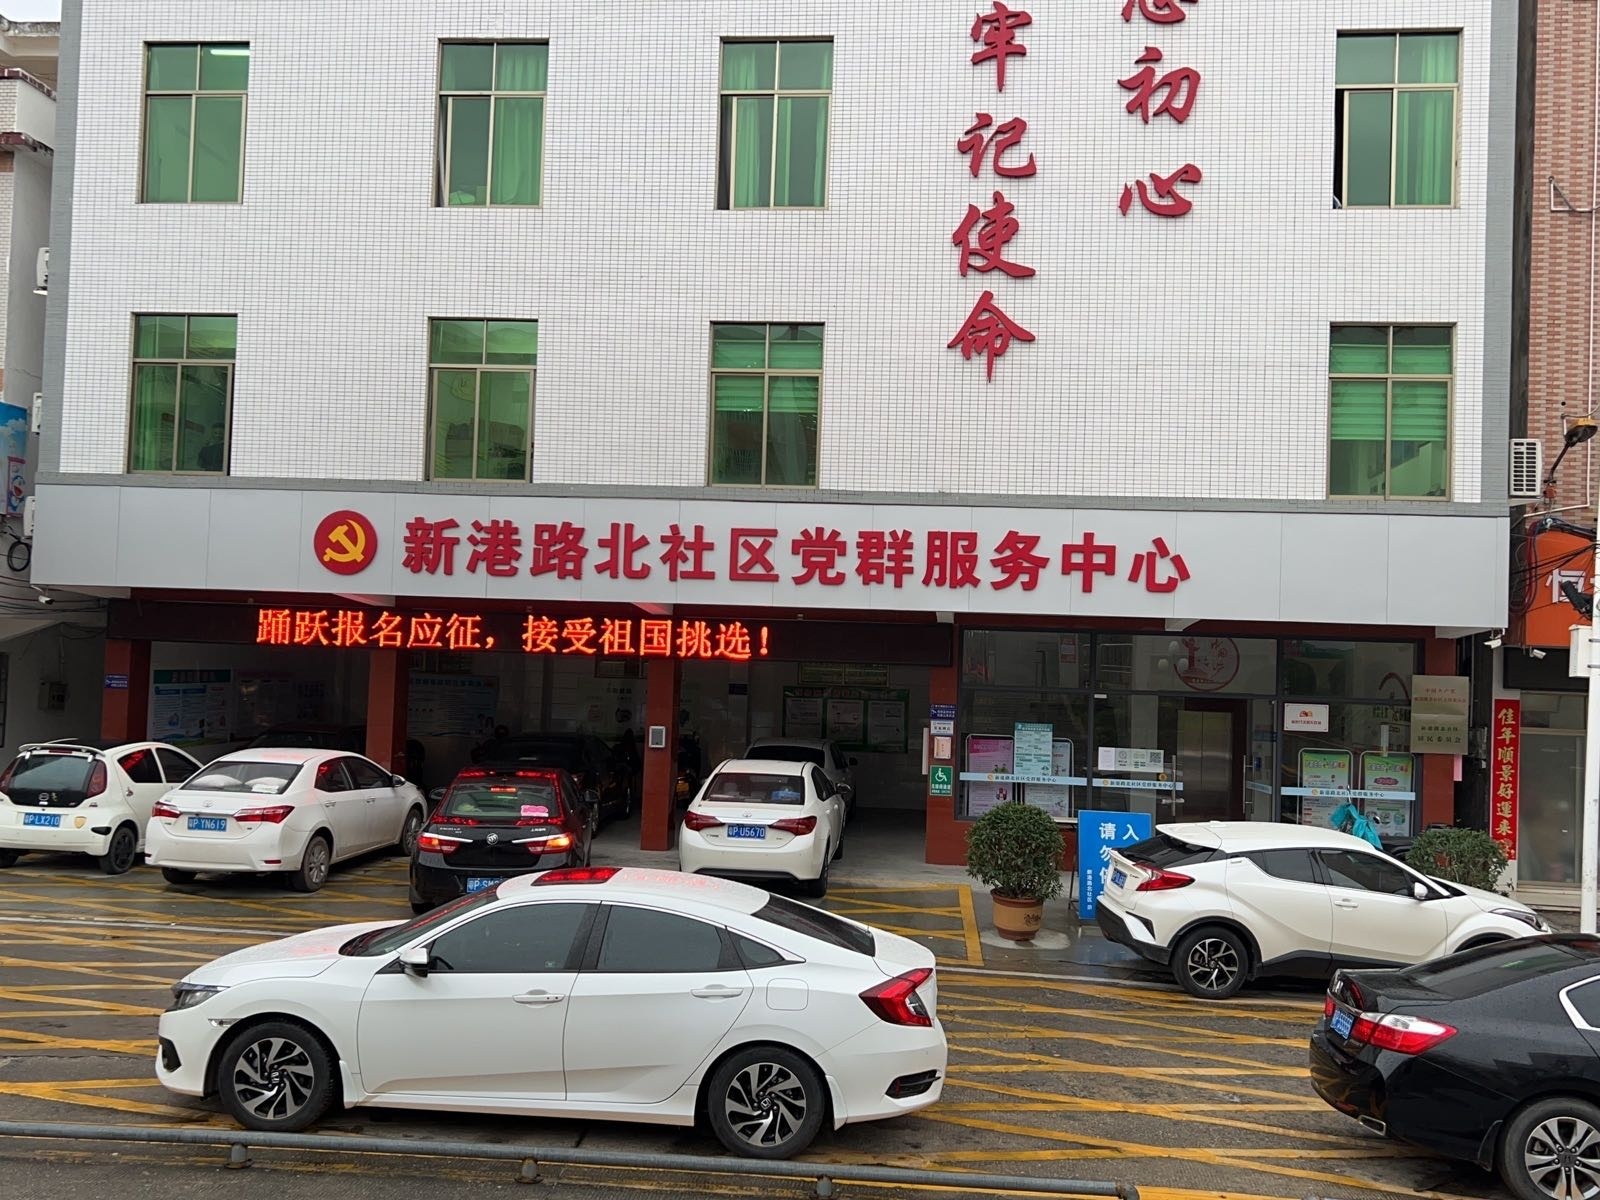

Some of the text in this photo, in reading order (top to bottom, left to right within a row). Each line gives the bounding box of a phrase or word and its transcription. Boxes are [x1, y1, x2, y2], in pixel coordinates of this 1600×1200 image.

[947, 1, 1037, 383] 牢记使命
[402, 516, 1191, 594] 新港路北社区党群服务中心
